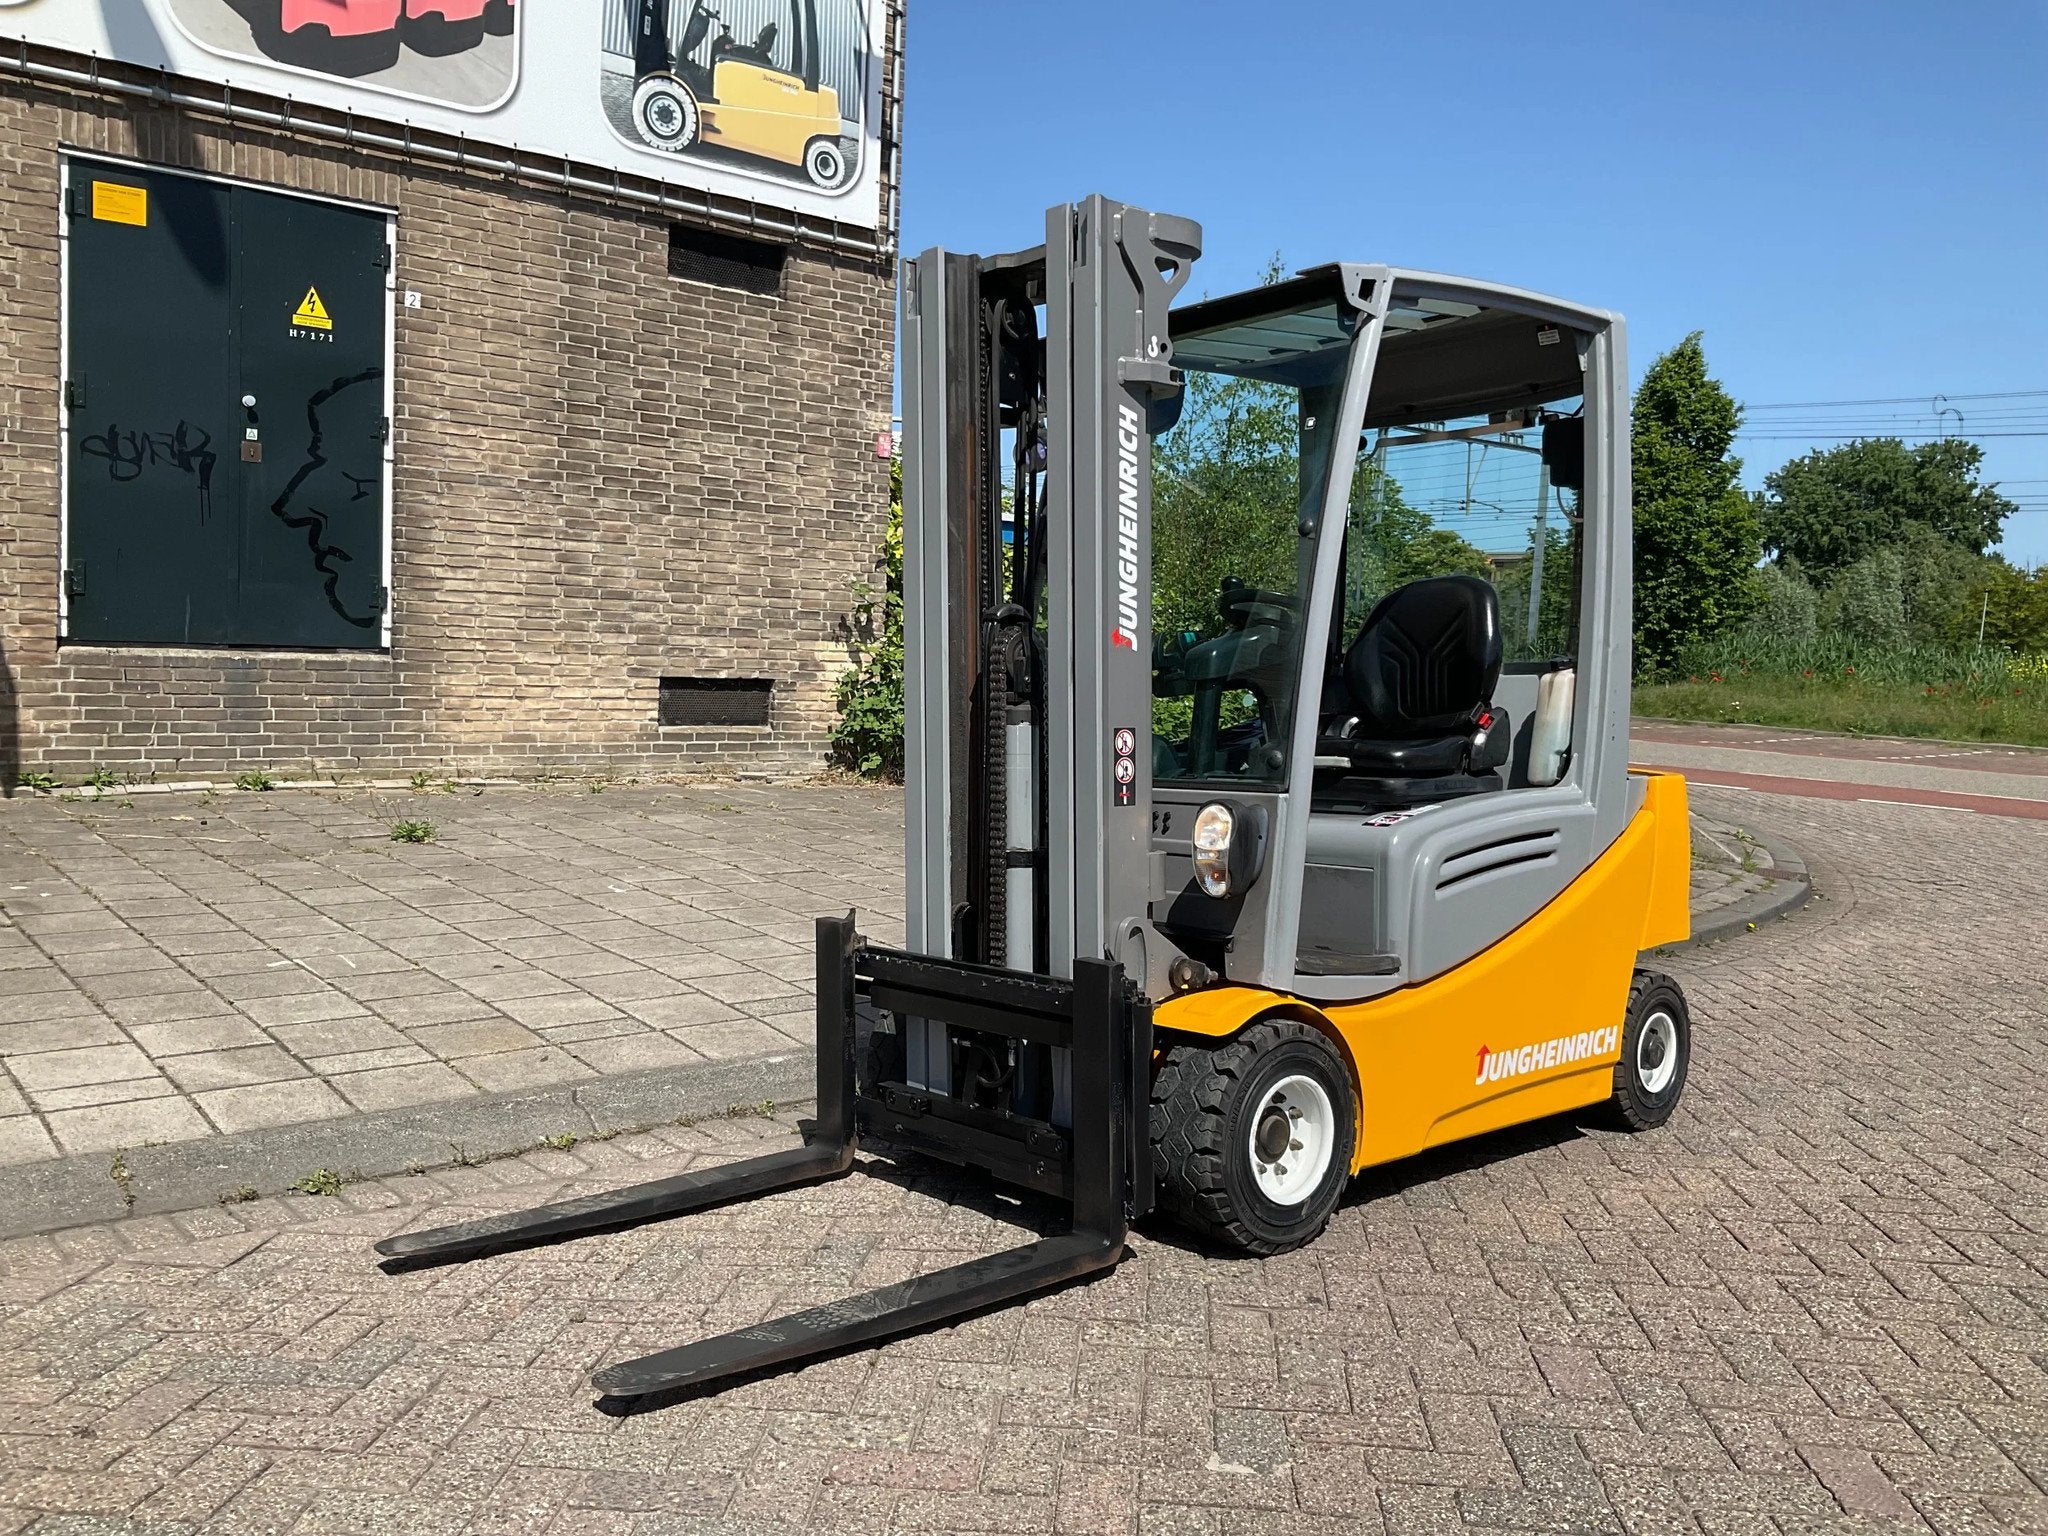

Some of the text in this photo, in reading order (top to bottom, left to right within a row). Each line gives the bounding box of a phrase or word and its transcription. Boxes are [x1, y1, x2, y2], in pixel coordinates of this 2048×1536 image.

[409, 293, 417, 307] 2
[1118, 403, 1138, 652] JUNGHEINRICH
[1475, 1025, 1618, 1086] JUNGHEINRICH
